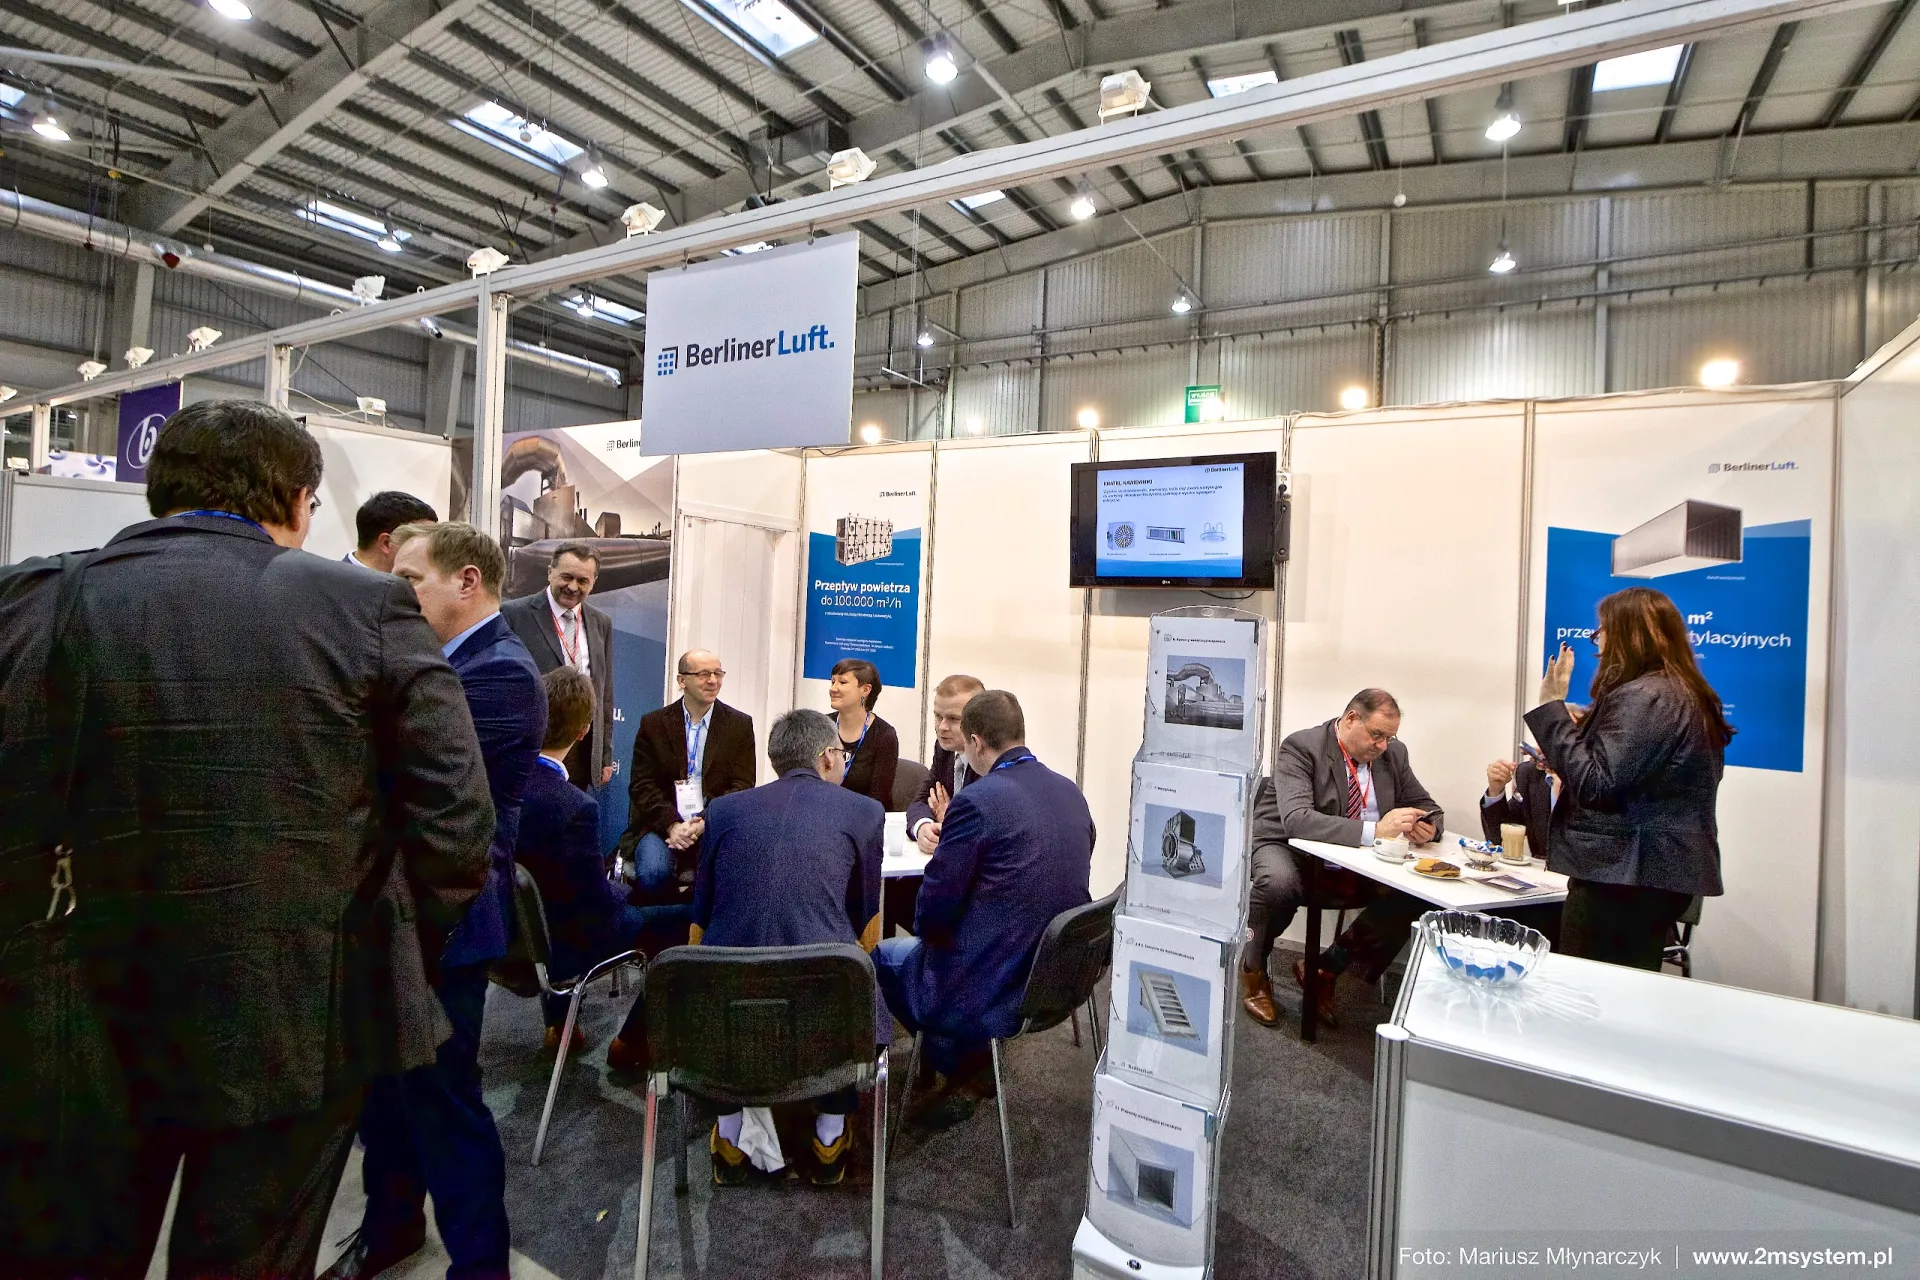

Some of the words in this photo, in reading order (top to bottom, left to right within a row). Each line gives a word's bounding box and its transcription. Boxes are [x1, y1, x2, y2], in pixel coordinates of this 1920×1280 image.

[814, 579, 859, 593] Przepływ
[860, 582, 911, 594] powietrza
[820, 595, 833, 606] do
[834, 595, 874, 607] 100.000
[1688, 630, 1792, 649] tylacyjnych
